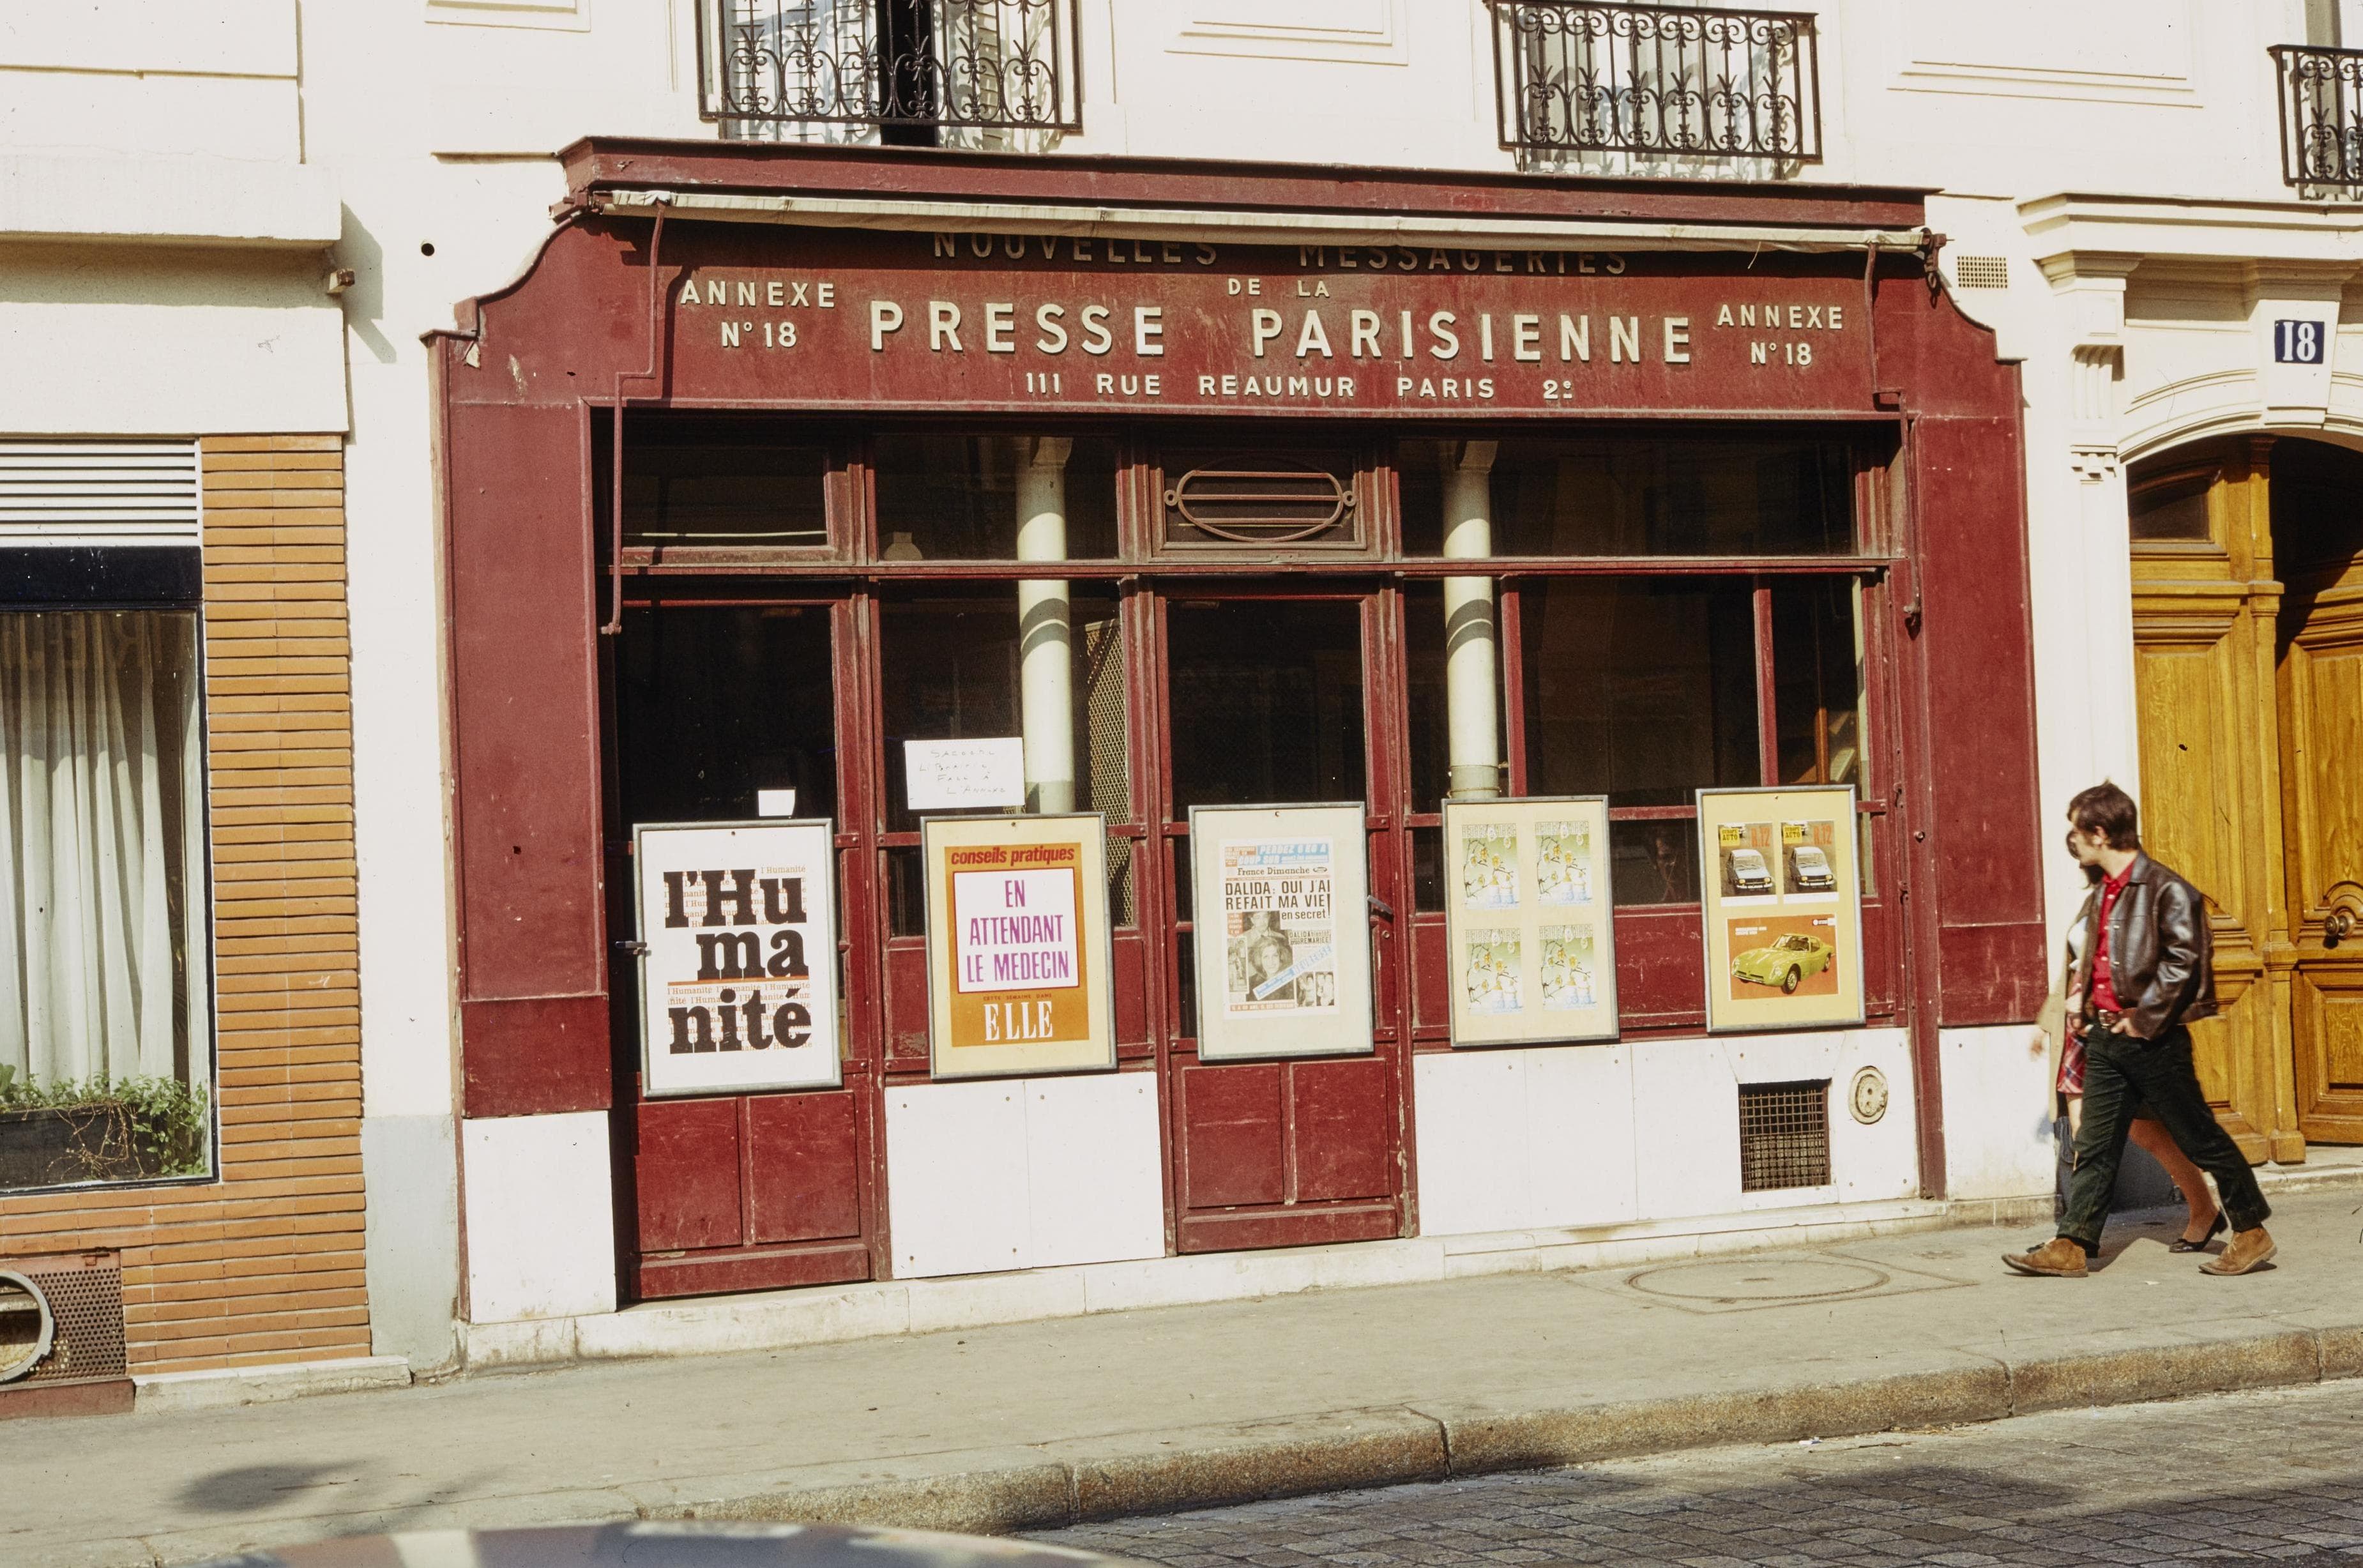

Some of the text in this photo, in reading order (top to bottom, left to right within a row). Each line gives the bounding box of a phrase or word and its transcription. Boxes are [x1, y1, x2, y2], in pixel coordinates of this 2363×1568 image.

[934, 232, 1626, 275] NOUVELLES MESSAGERIES
[680, 280, 835, 308] ANNEXE
[1227, 278, 1330, 297] DE LA
[1717, 304, 1843, 330] ANNEXE
[721, 321, 797, 348] N° 18
[870, 300, 1690, 363] PRESSE PARISIENNE
[2283, 321, 2316, 362] 18
[1751, 342, 1812, 366] N° 18
[1097, 374, 1160, 396] RUE
[1198, 376, 1355, 398] REAUMUR
[1397, 378, 1495, 399] PARIS
[951, 845, 1075, 867] conseils pratiques
[1267, 866, 1310, 875] Dimanche
[663, 869, 807, 928] l'Hu
[1005, 879, 1026, 908] EN
[1281, 881, 1302, 894] OUI
[1226, 896, 1272, 910] REFAIT
[1279, 895, 1298, 908] MA
[1282, 911, 1293, 920] en
[969, 915, 1063, 946] ATTENDANT
[696, 929, 809, 981] ma
[967, 950, 1069, 982] LE MEDECIN
[669, 988, 812, 1054] nité
[983, 1001, 1053, 1041] ELLE
